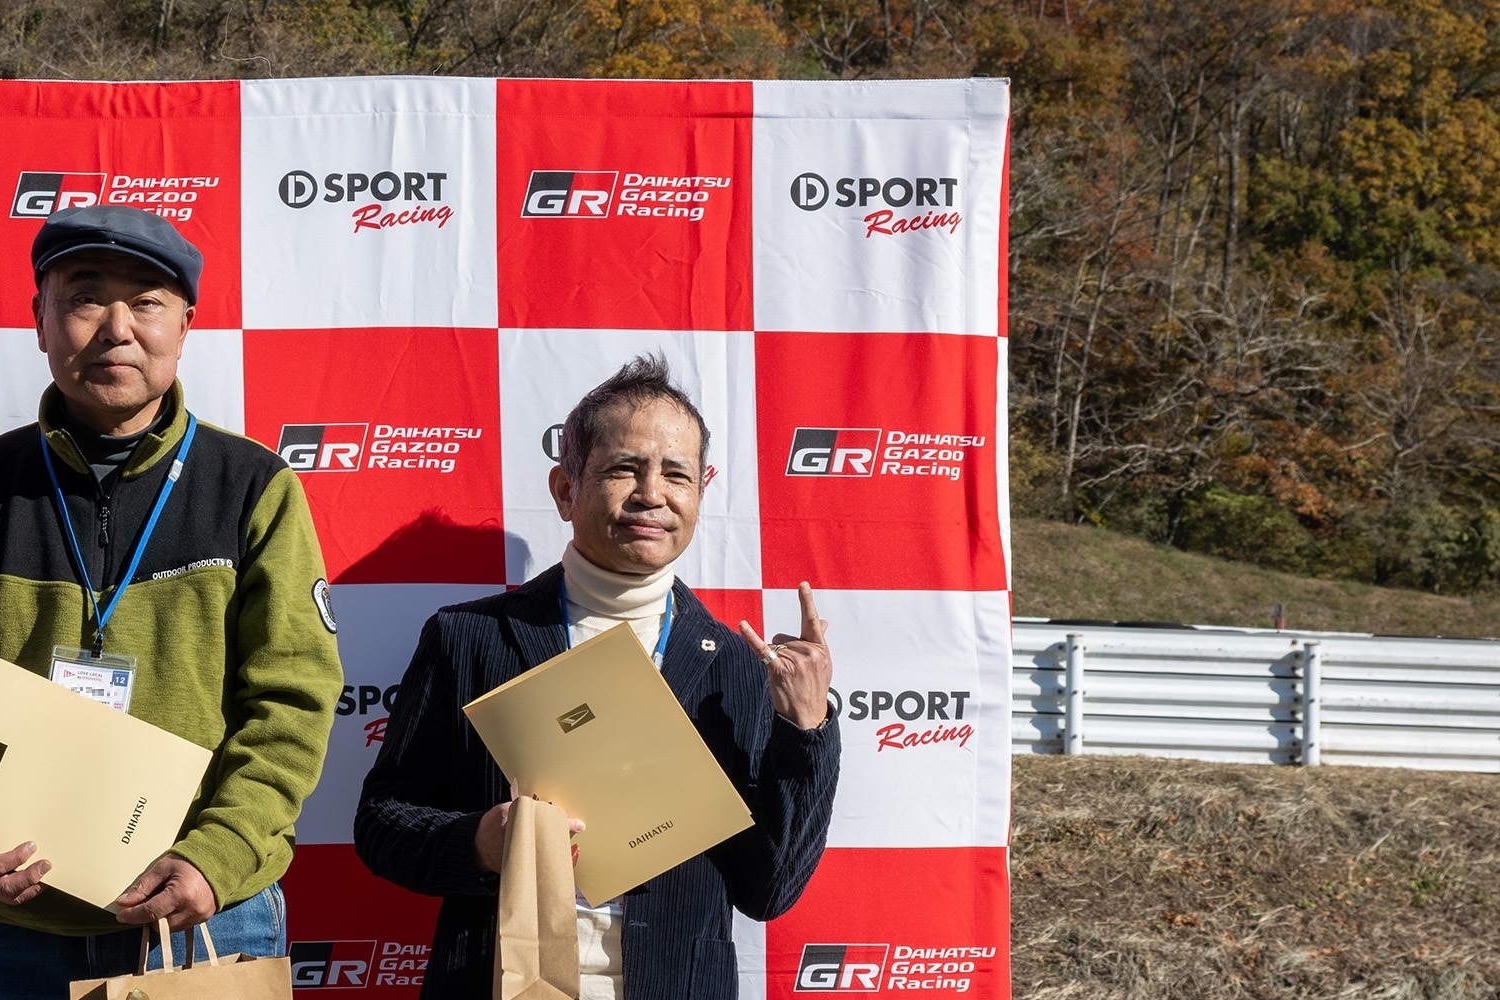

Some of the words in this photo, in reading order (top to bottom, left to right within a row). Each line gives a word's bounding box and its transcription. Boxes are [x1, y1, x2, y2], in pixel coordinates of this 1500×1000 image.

[111, 175, 219, 189] DAIHATSU
[323, 171, 447, 202] SPORT
[623, 174, 730, 188] DAIHATSU
[108, 190, 197, 203] GAZOO
[620, 189, 708, 203] GAZOO
[835, 178, 957, 207] SPORT
[526, 190, 609, 215] GR
[352, 204, 454, 233] Racing
[617, 203, 705, 221] Racing
[864, 209, 962, 238] Racing
[374, 425, 482, 440] DAIHATSU
[886, 432, 985, 447] DAIHATSU
[281, 443, 360, 469] GR
[371, 440, 460, 454] GAZOO
[884, 447, 964, 461] GAZOO
[368, 454, 455, 472] Racing
[791, 448, 873, 474] GR
[881, 462, 960, 480] Racing
[152, 566, 186, 580] OUTDOOR
[188, 558, 225, 571] PRODUCTS
[115, 676, 126, 684] 12
[848, 690, 970, 720] SPORT
[876, 723, 974, 752] Racing
[121, 796, 148, 845] DAIHATSU
[628, 820, 674, 849] DAIHATSU
[894, 946, 996, 960] DAIHATSU
[292, 961, 363, 986] GR
[800, 963, 880, 988] GR
[890, 962, 975, 974] GAZOO
[887, 976, 970, 992] Racing
